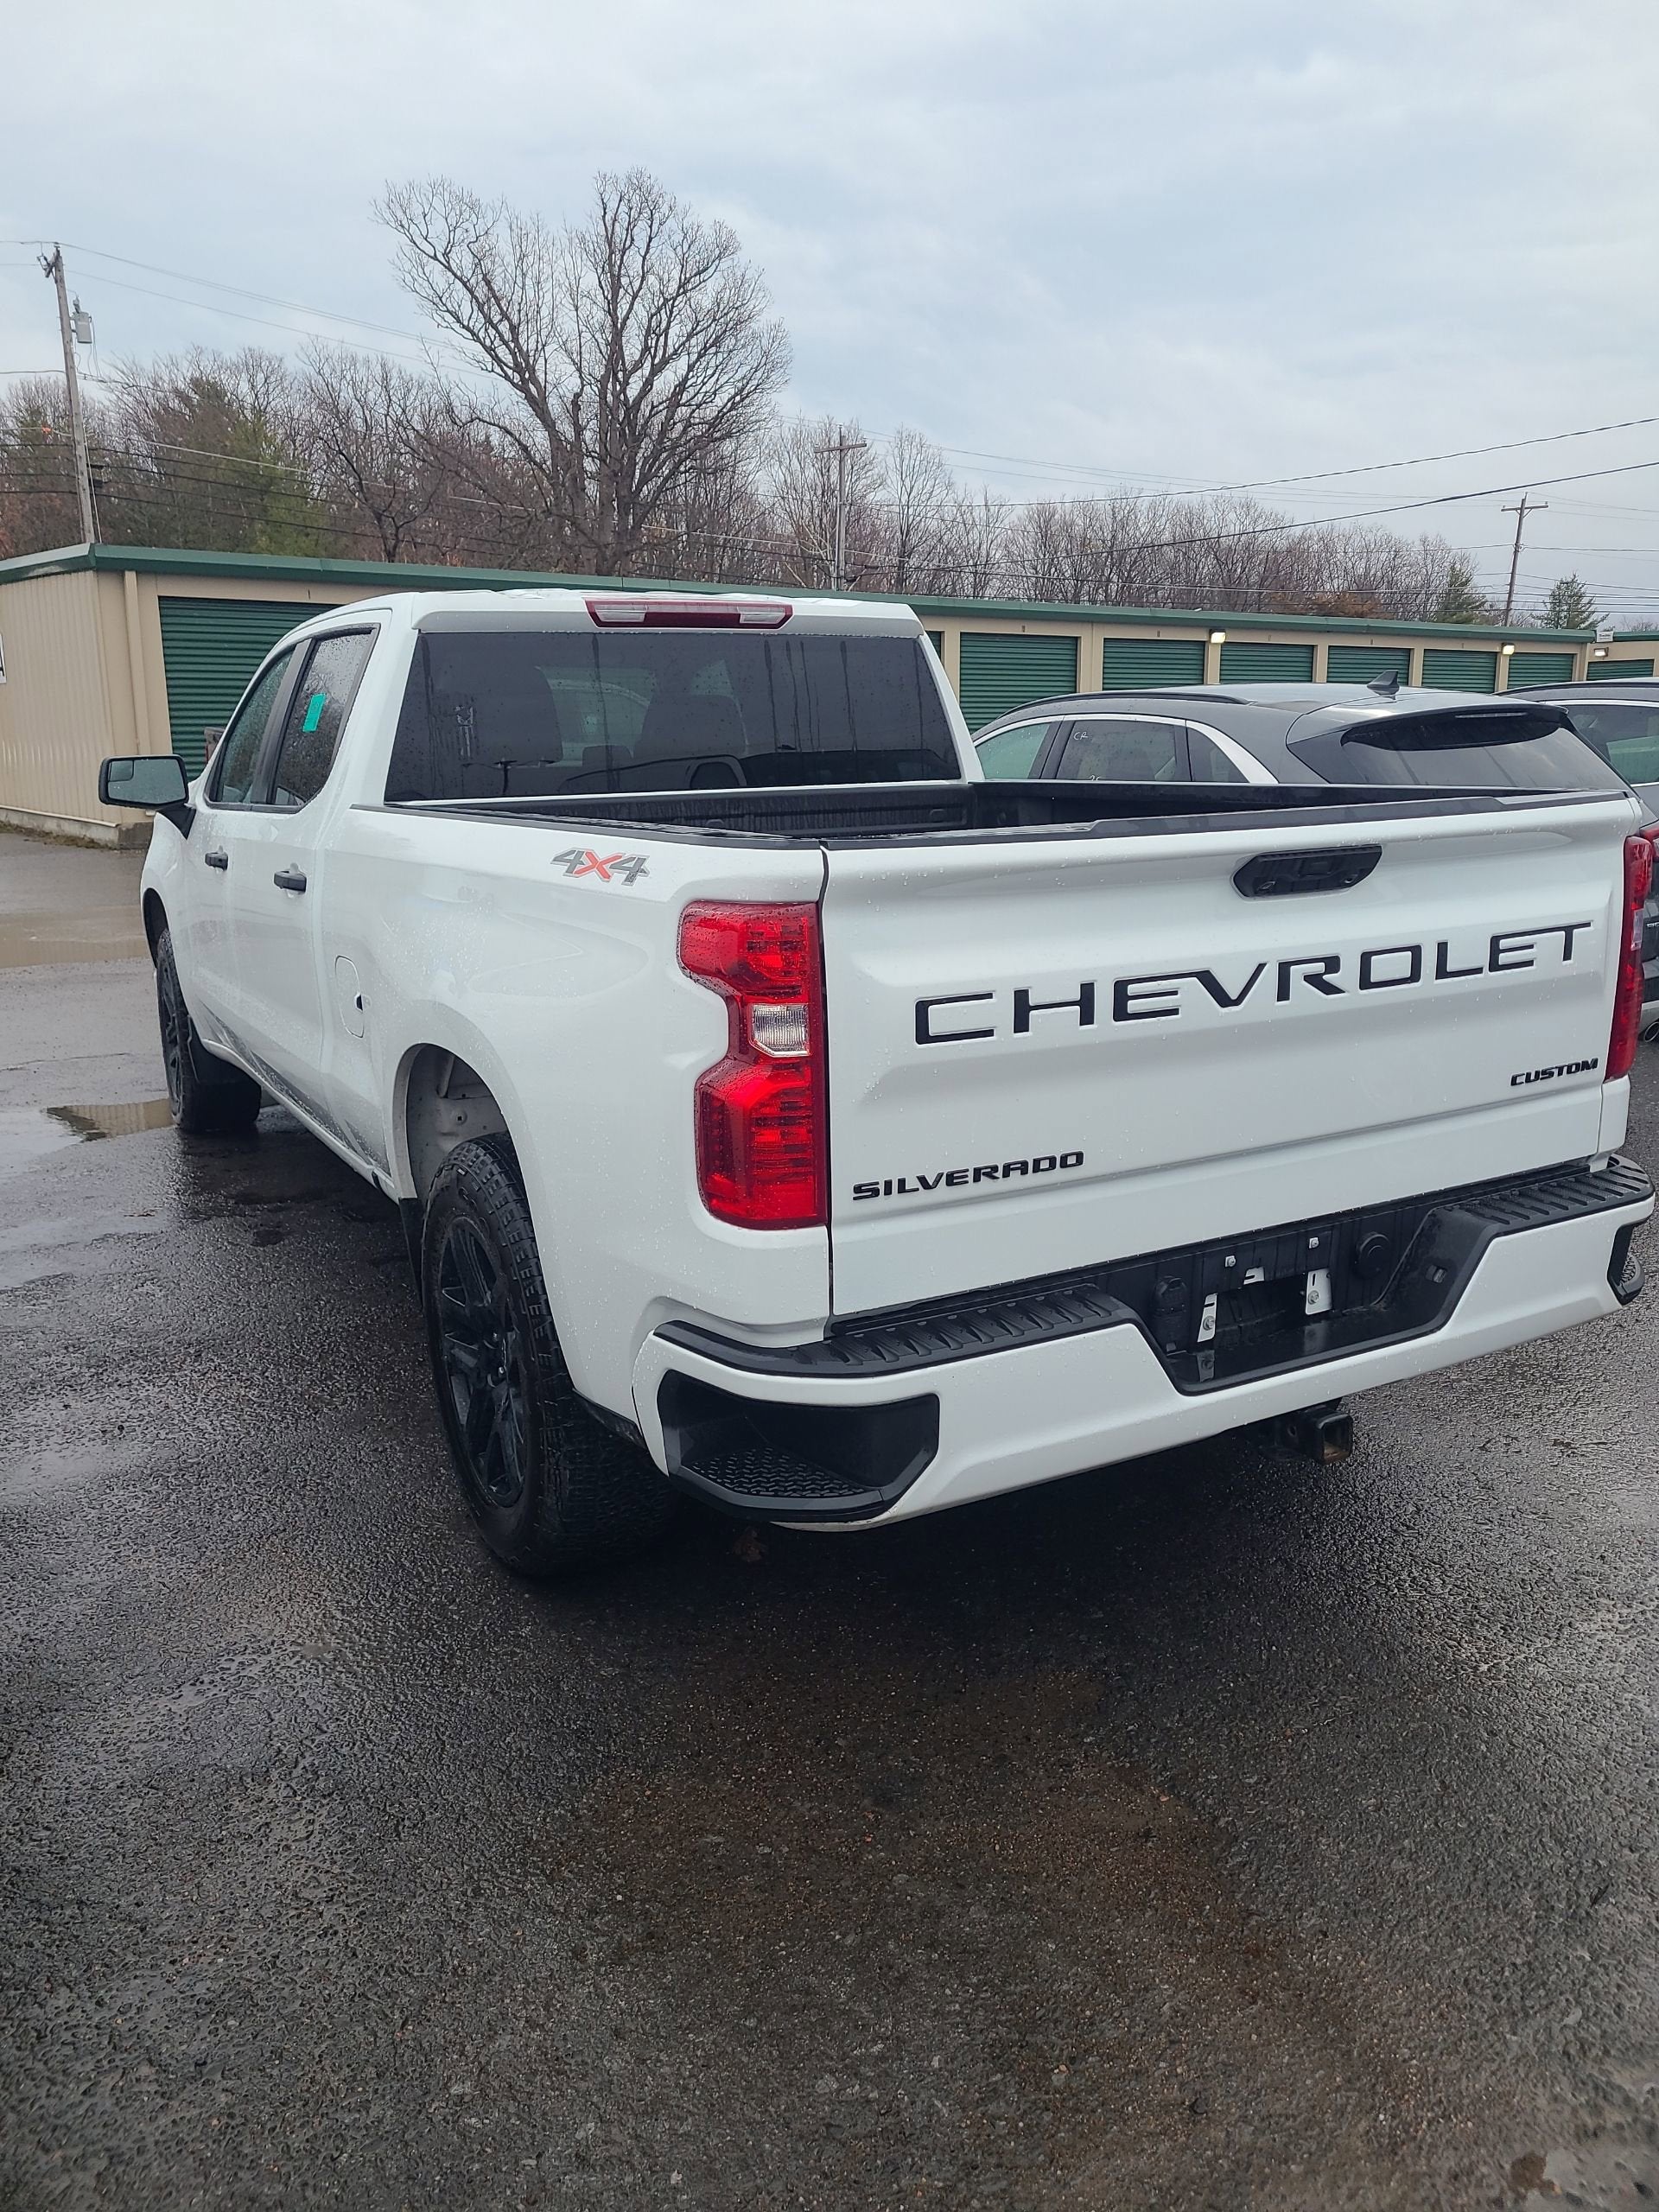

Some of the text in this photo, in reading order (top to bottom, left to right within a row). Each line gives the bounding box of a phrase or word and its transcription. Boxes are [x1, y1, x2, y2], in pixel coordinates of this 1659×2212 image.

[914, 920, 1592, 1046] CHEVROLET
[1510, 1058, 1599, 1086] CUSTOM
[852, 1150, 1084, 1201] SILVERADO
